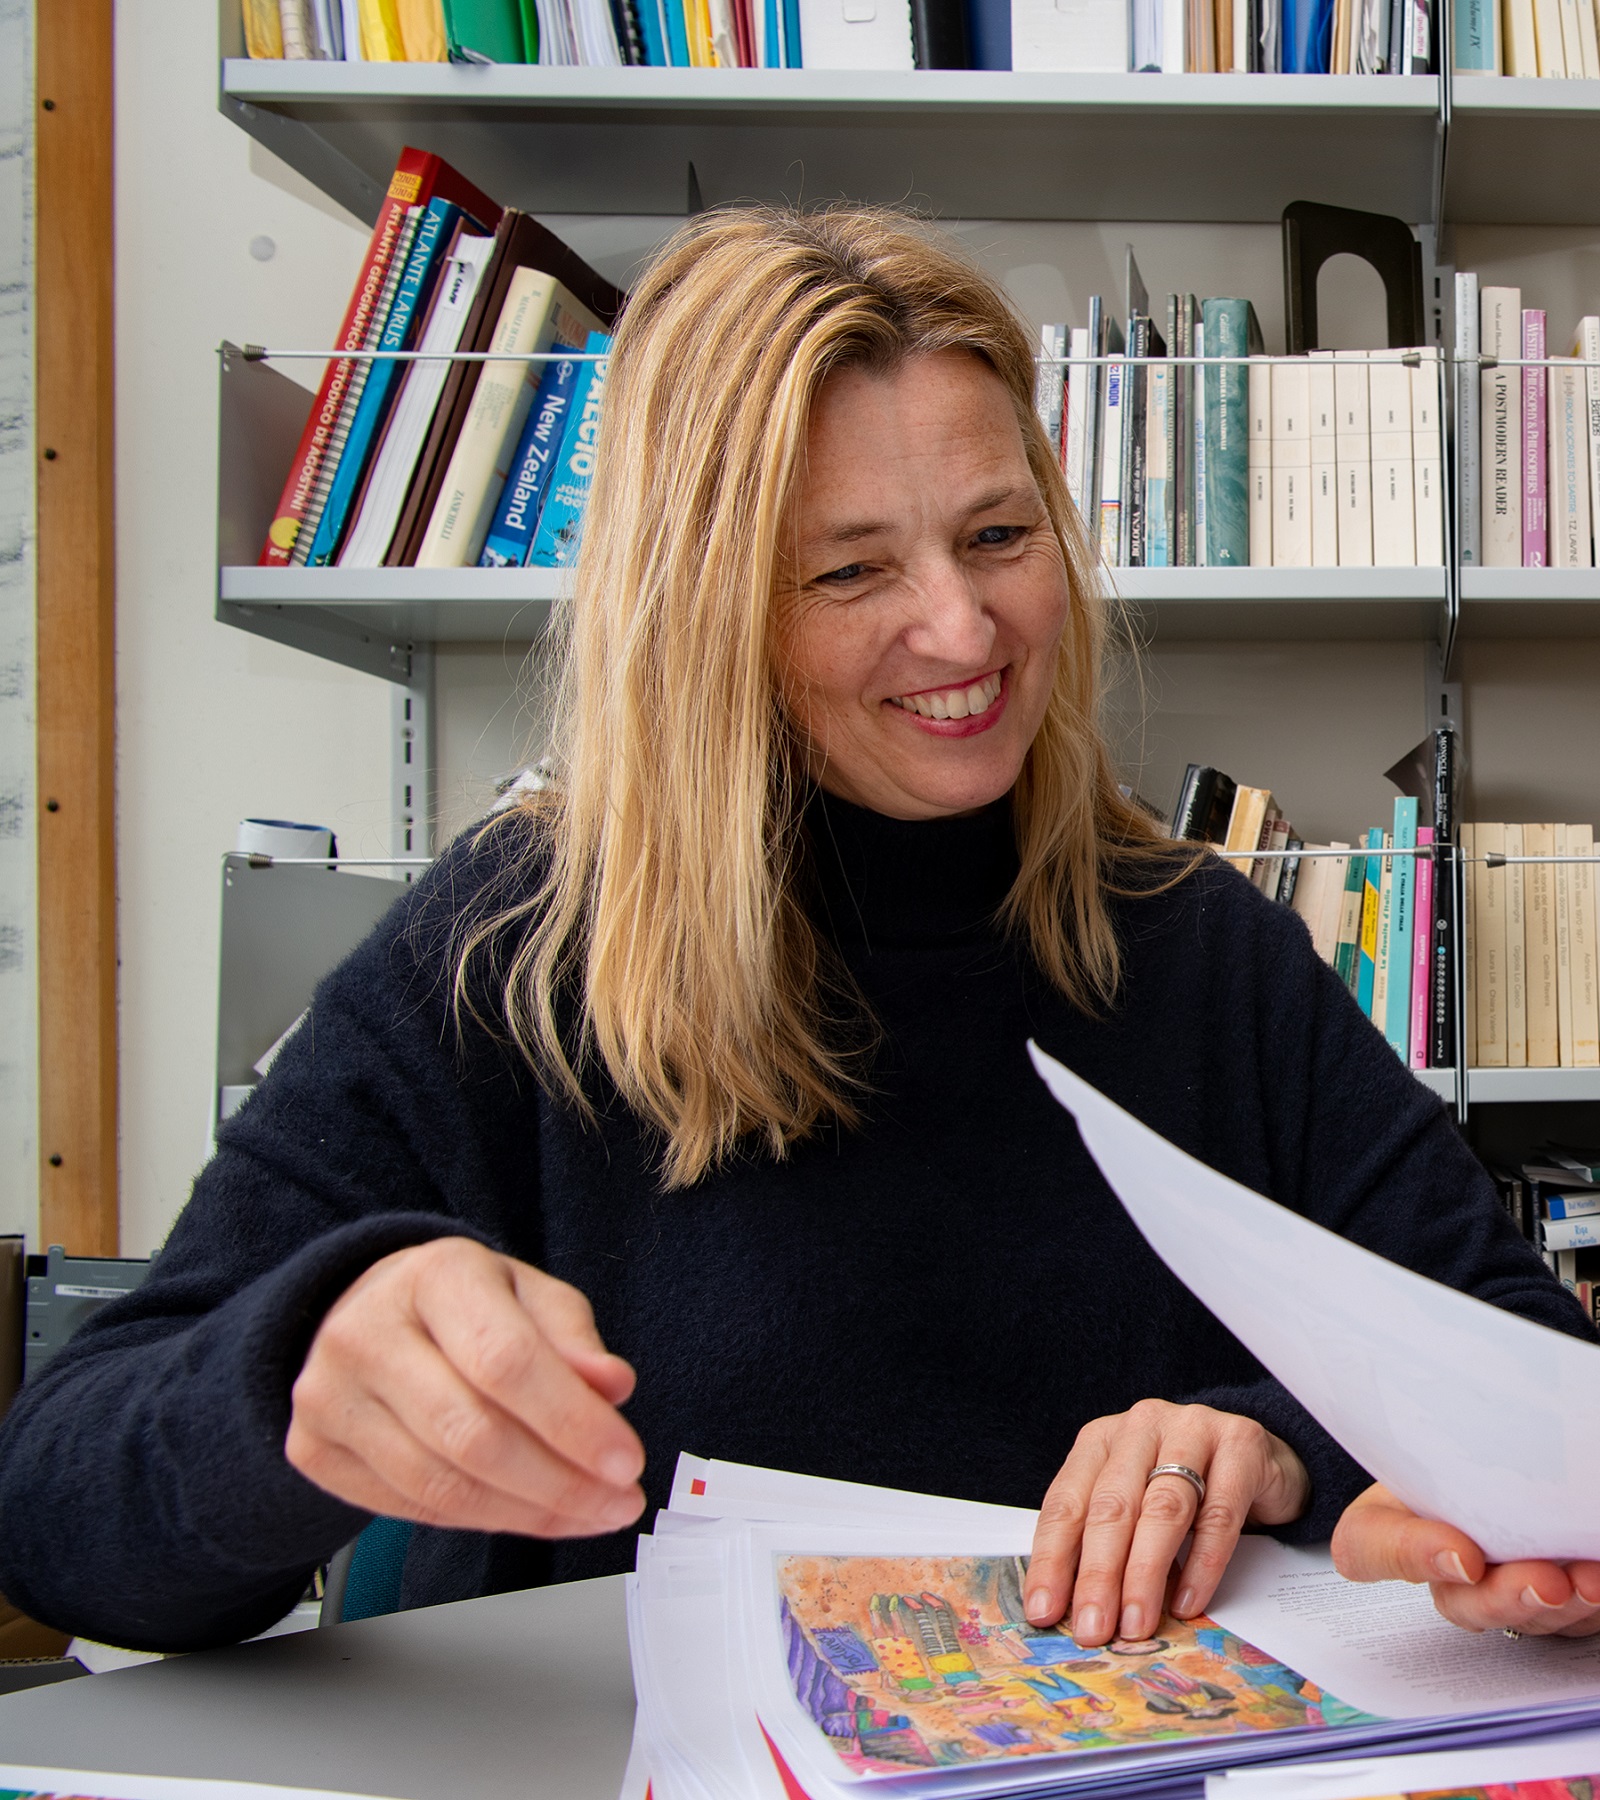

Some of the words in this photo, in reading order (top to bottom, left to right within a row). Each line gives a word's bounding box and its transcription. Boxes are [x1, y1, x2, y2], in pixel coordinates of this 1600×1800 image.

[374, 202, 403, 263] ATLANTE
[403, 209, 441, 289] ATLANTE
[344, 265, 383, 352] GEOGRAFICO
[383, 292, 416, 348] LARUS
[1136, 324, 1145, 358] ITALIANO
[1526, 322, 1540, 360] WESTER
[1108, 373, 1121, 407] LONDON
[1495, 372, 1508, 381] A
[1526, 368, 1540, 420] PHILOSOPHY
[534, 394, 567, 443] New
[1494, 383, 1508, 466] POSTMODERN
[1526, 421, 1538, 429] &
[1564, 397, 1575, 425] FROM
[311, 425, 329, 447] DE
[1565, 425, 1577, 470] SOCRATES
[1526, 430, 1540, 494] PHILOSOPHERS
[1567, 471, 1577, 483] TO
[290, 444, 322, 511] AGOSTINI
[504, 442, 550, 531] Zealand
[1495, 468, 1508, 516] READER
[1567, 483, 1578, 514] SARTRE
[438, 488, 465, 541] ZANICHELLI
[1131, 511, 1141, 558] BOLOGNA
[1568, 533, 1579, 563] LAVINE
[1439, 735, 1449, 777] MONOCLE
[1540, 872, 1549, 893] storia
[1557, 878, 1567, 896] delle
[1511, 886, 1521, 924] casalinghe
[1534, 893, 1543, 912] Italia
[1540, 893, 1549, 907] del
[1559, 896, 1567, 918] donne
[1575, 889, 1584, 909] Italia
[1541, 906, 1551, 945] movimento
[1559, 926, 1568, 945] Rosa
[1379, 958, 1387, 970] La
[1488, 949, 1497, 971] Laura
[1542, 953, 1552, 981] Camilla
[1560, 945, 1568, 967] Rossi
[1584, 952, 1593, 980] Adriana
[1513, 972, 1521, 983] Lo
[1488, 988, 1498, 1014] Chiara
[1543, 981, 1553, 1008] Ravera
[1585, 980, 1593, 1006] Seroni
